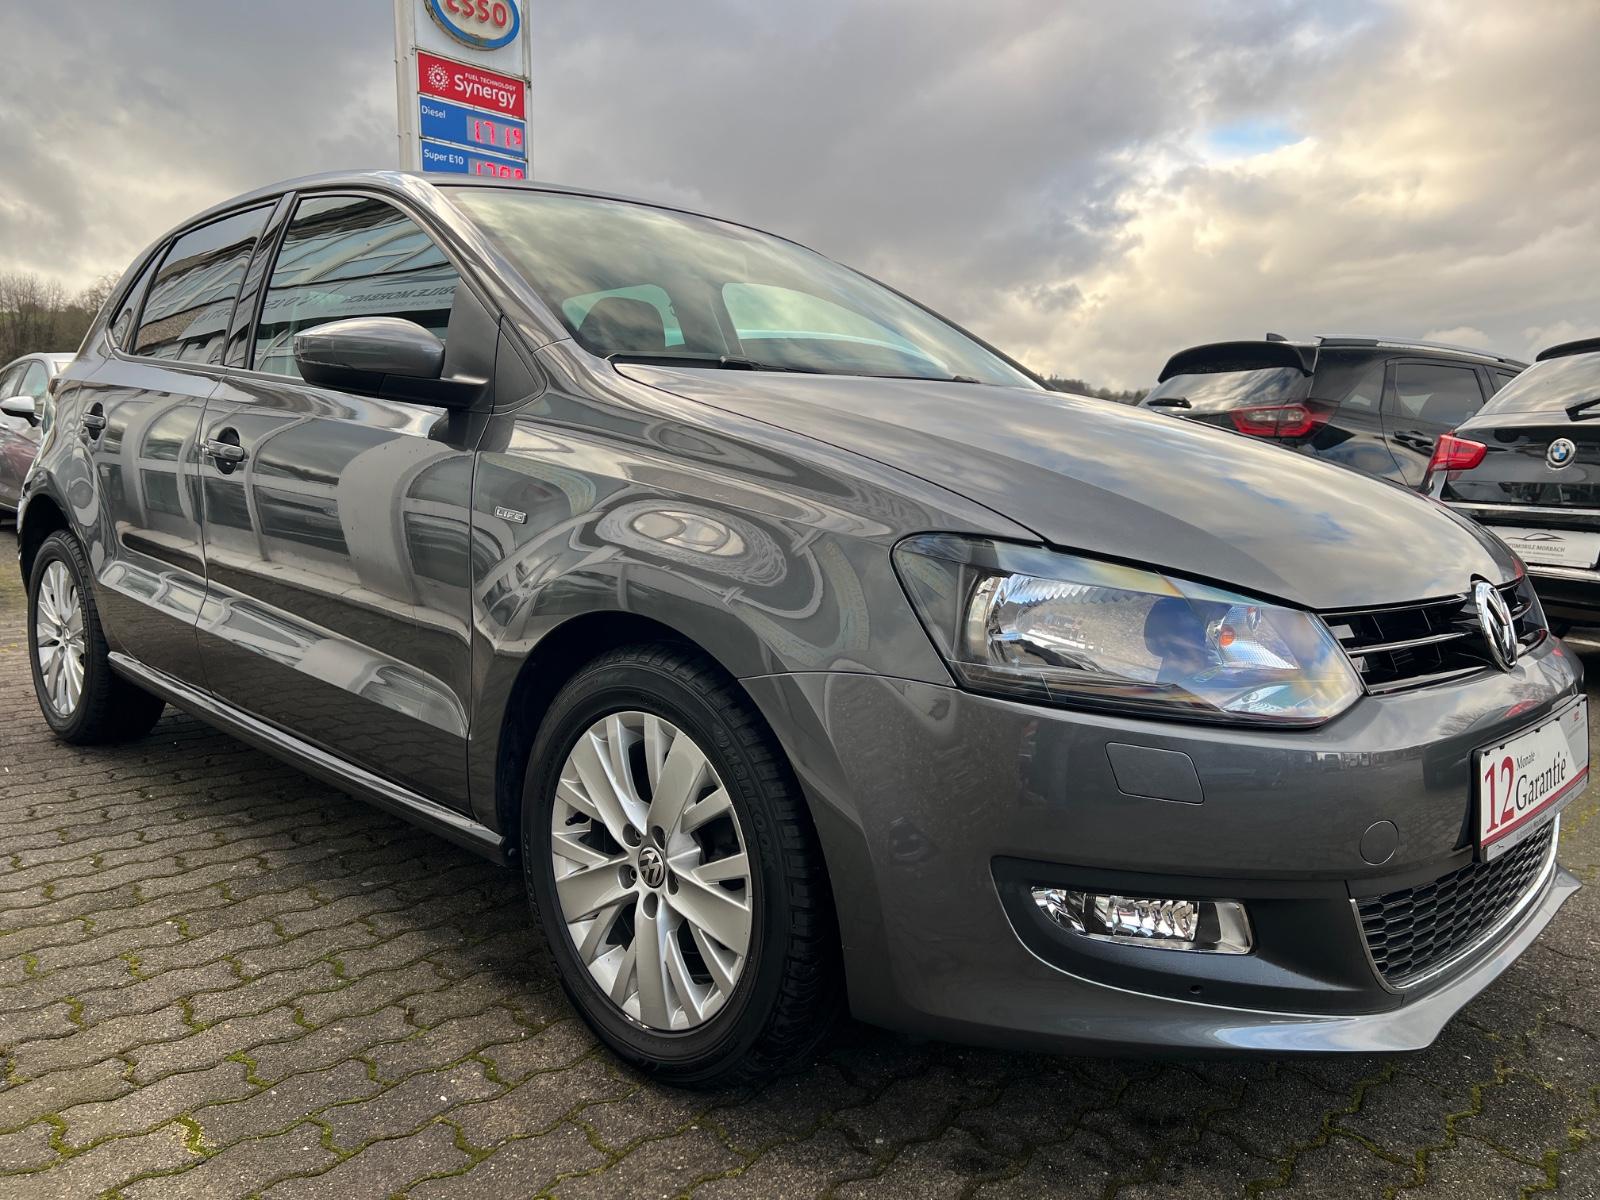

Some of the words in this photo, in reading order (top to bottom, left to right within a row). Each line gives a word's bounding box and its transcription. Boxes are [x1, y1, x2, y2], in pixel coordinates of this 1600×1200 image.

[465, 72, 479, 81] FUEL
[480, 76, 516, 91] TECHNOLOGY
[454, 74, 516, 109] Synergy
[421, 105, 446, 118] Diesel
[424, 149, 447, 161] Super
[449, 154, 464, 165] E10
[1484, 756, 1514, 834] 12
